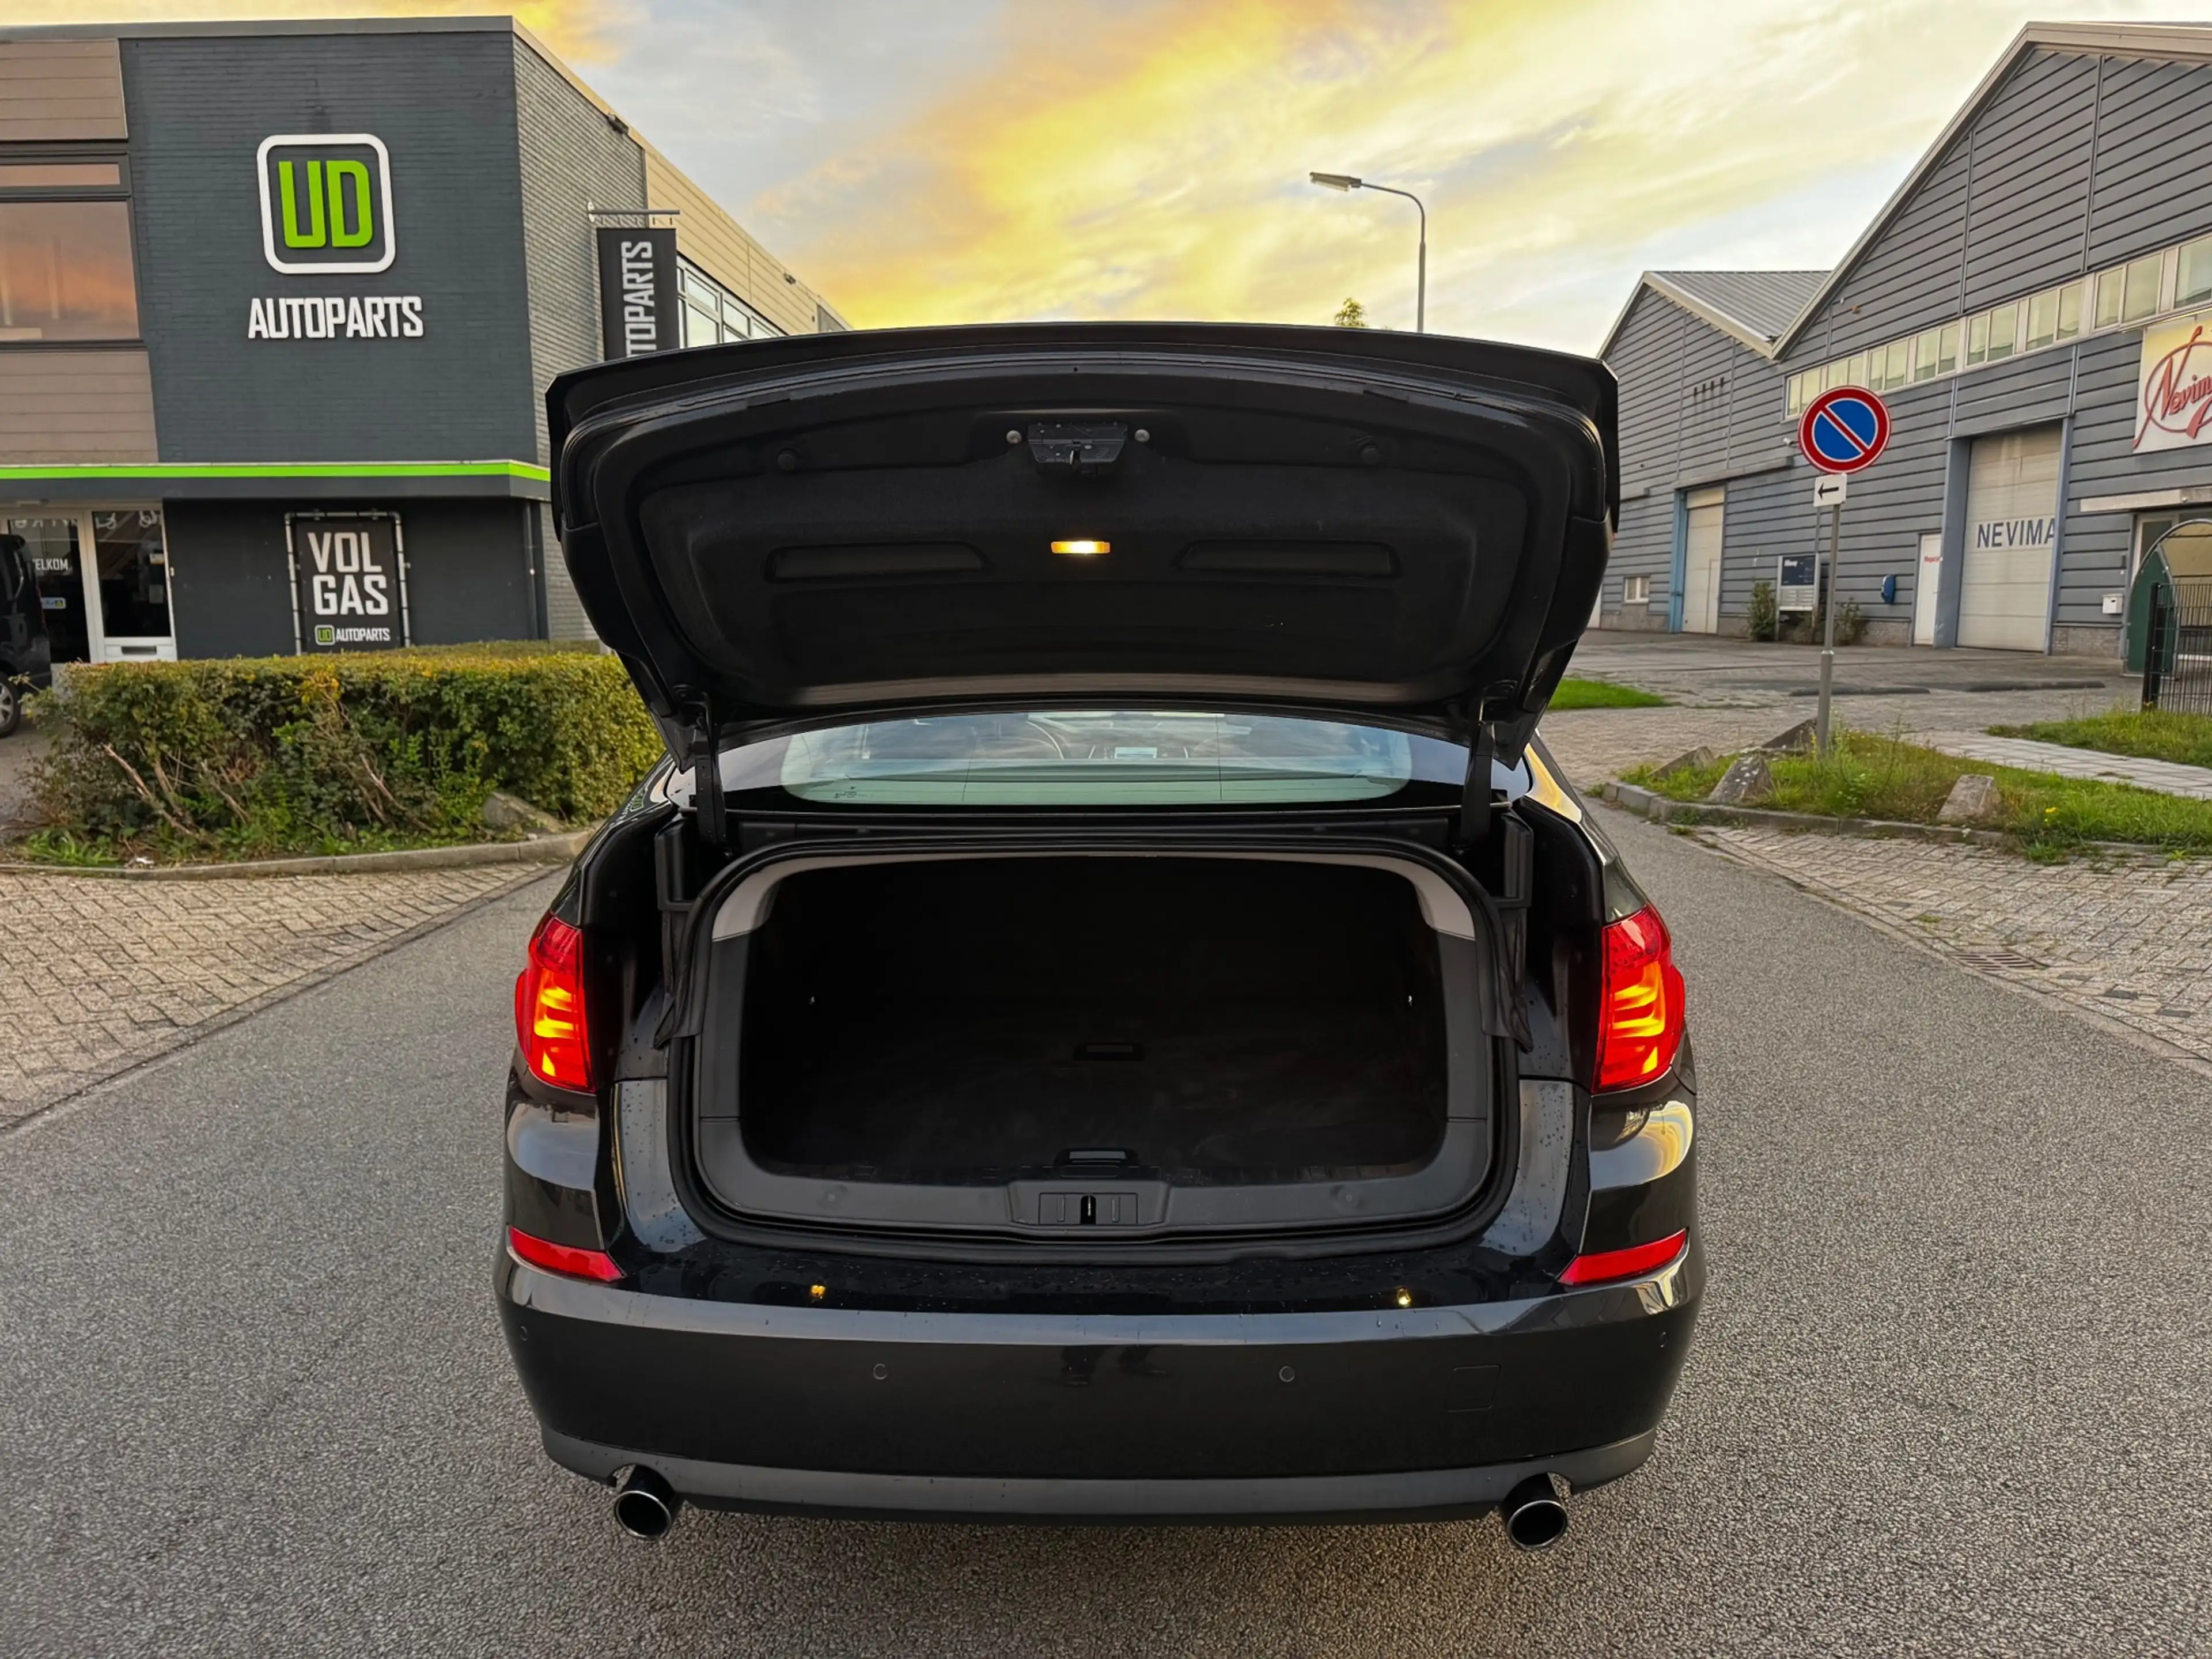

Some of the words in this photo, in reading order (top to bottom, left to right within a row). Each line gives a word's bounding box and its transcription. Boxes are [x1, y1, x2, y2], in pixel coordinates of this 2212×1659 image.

[279, 160, 372, 247] UD
[248, 296, 423, 339] AUTOPARTS
[621, 241, 657, 358] TOPARTS
[33, 558, 69, 570] ELKOM
[307, 532, 382, 573] VOL
[313, 574, 389, 615] GAS
[336, 627, 391, 642] AUTOPARTS
